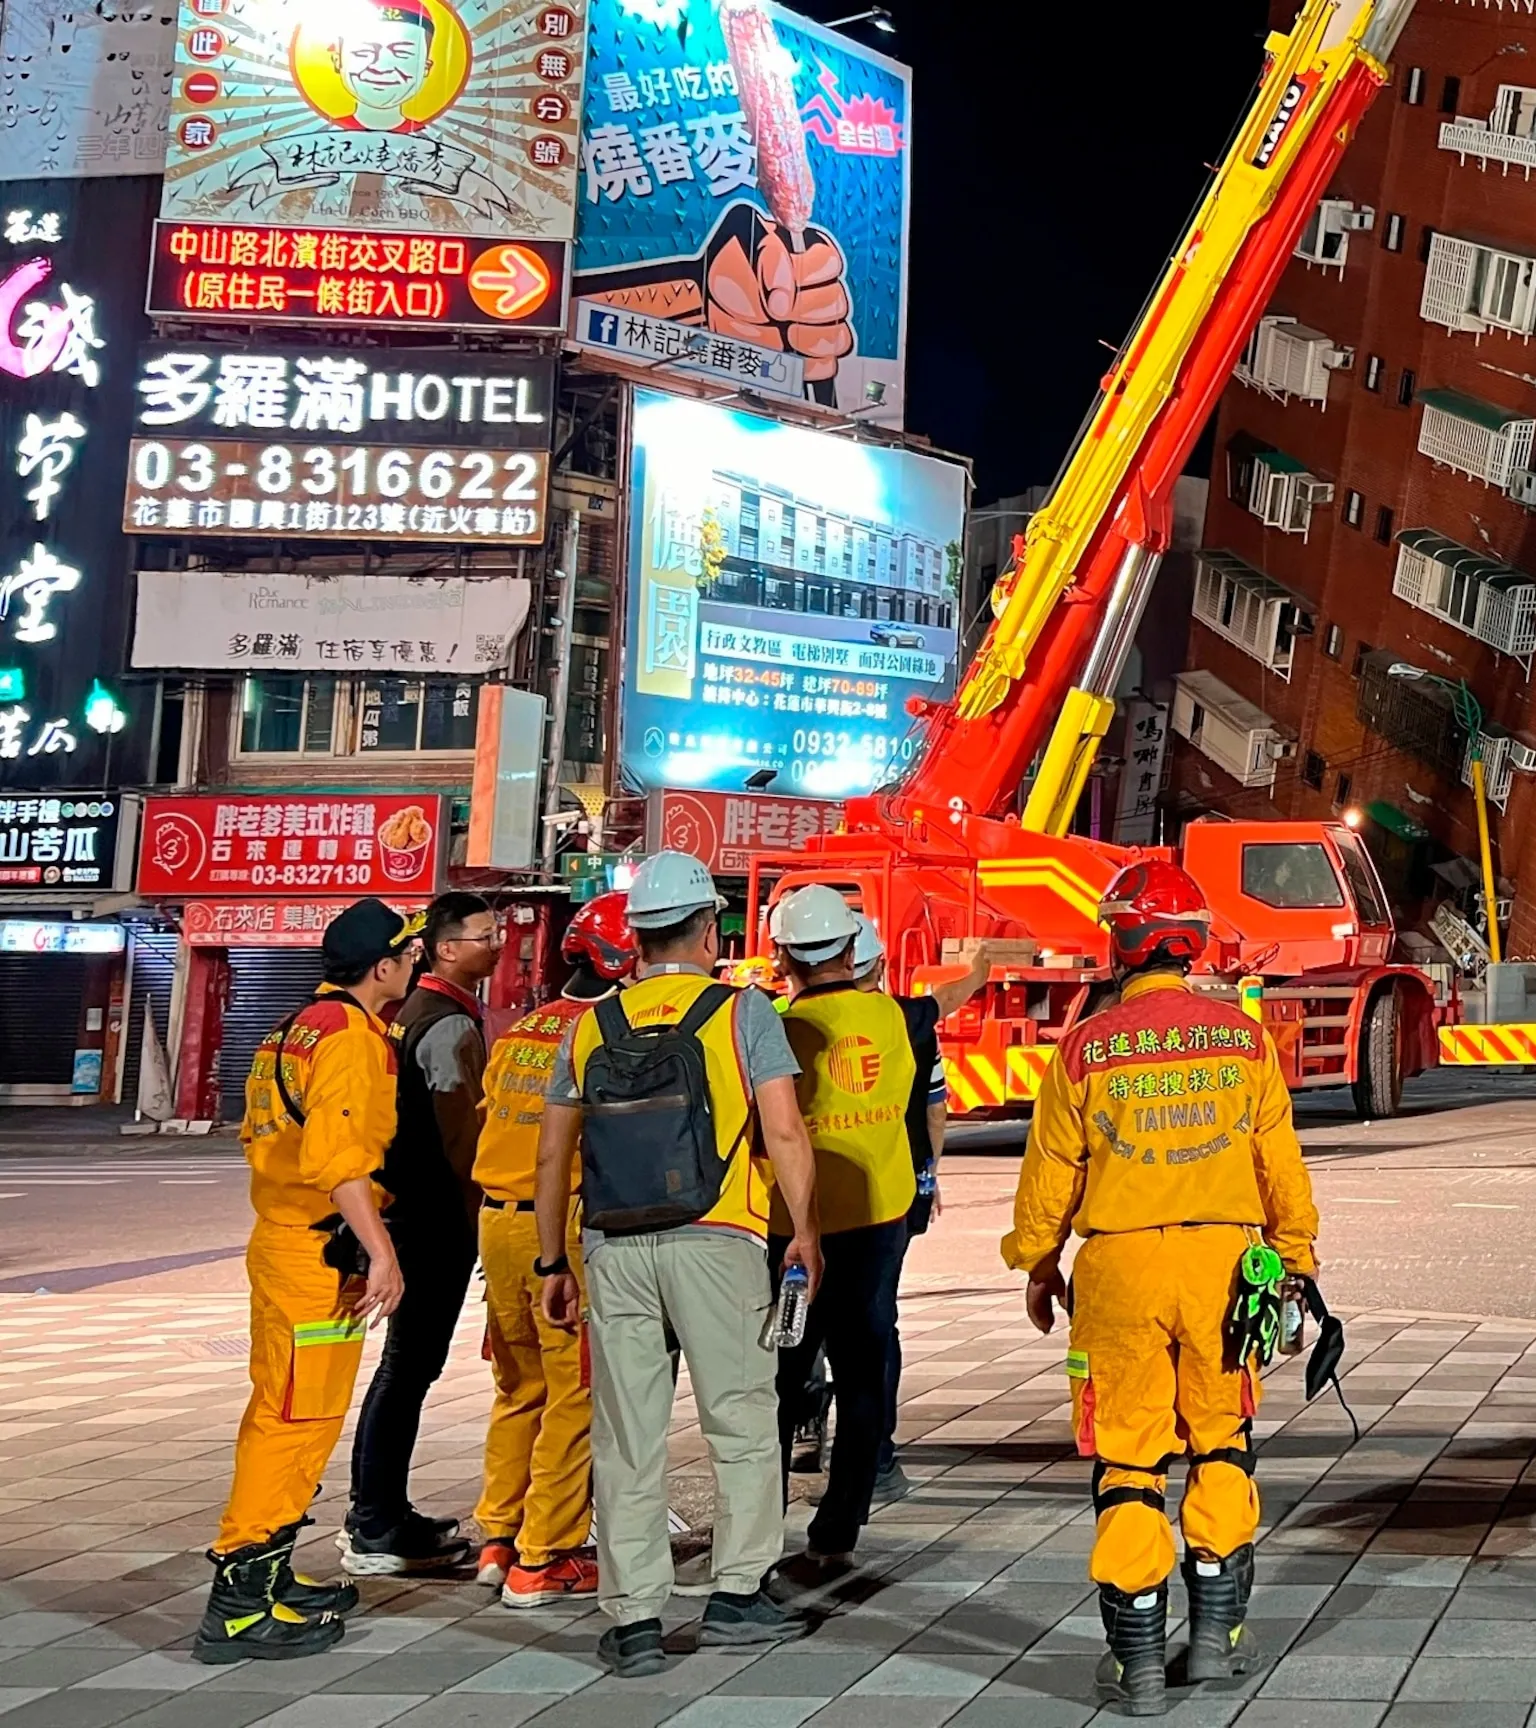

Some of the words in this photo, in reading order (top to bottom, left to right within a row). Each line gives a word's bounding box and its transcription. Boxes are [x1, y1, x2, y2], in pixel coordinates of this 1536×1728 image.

[534, 13, 568, 165] 別無分號
[602, 59, 738, 113] 最好吃的
[584, 111, 758, 204] 燒番麥
[399, 207, 430, 220] BBQ
[169, 227, 465, 277] 中山路北濱街交叉路口
[183, 271, 444, 319] (原住民一條街入口)
[139, 353, 367, 432] 多羅滿
[370, 374, 544, 425] HOTEL
[134, 441, 538, 500] 03-8316622
[228, 633, 303, 660] 多羅滿
[706, 630, 783, 658] 行政文教區
[791, 642, 850, 668] 電梯別墅
[858, 651, 937, 677] 面對公園綠地
[702, 662, 795, 691] 地坪32-45坪
[362, 689, 382, 747] 地瓜粥
[213, 803, 376, 838] 胖老爹美式炸雞
[0, 827, 98, 862] 山苦瓜
[251, 864, 371, 886] 03-8327130
[214, 905, 276, 931] 石來店
[282, 904, 350, 931] 集點活
[1083, 1025, 1257, 1065] 花蓮縣義消總隊
[1108, 1065, 1245, 1100] 特種搜救隊
[1134, 1100, 1217, 1133] TAIWAN
[1141, 1148, 1156, 1165] &
[1166, 1132, 1232, 1165] RESCUE
